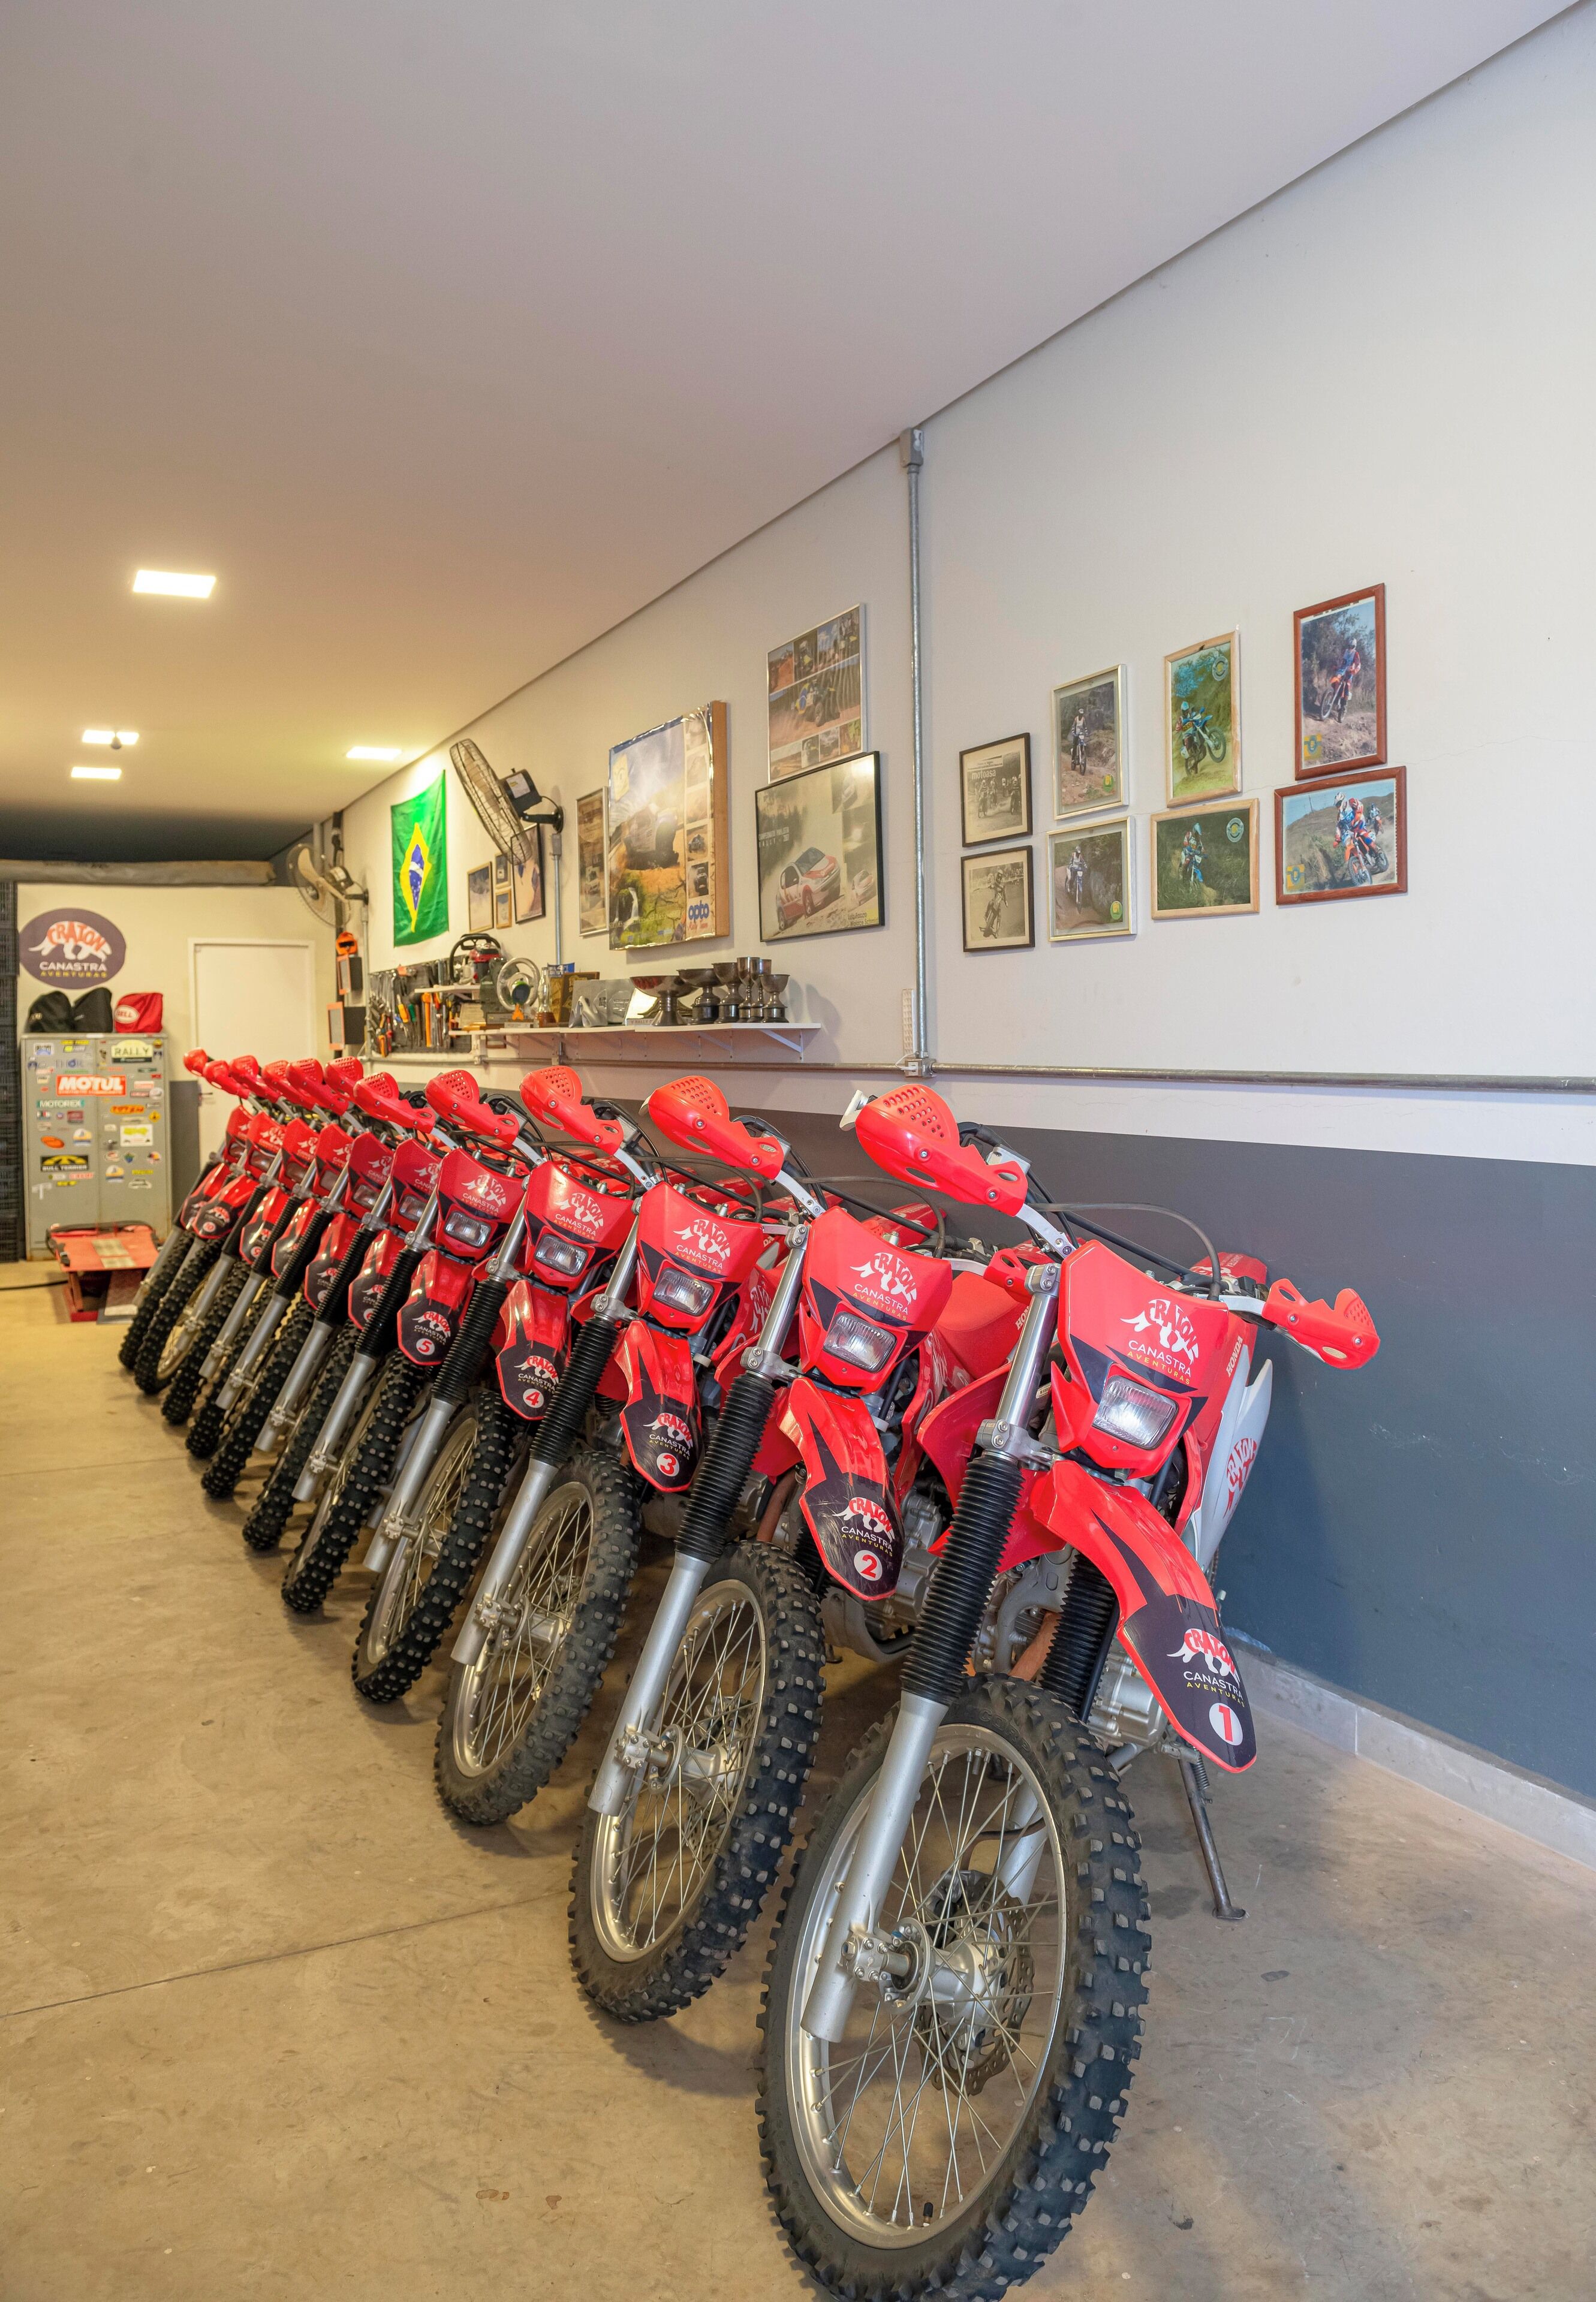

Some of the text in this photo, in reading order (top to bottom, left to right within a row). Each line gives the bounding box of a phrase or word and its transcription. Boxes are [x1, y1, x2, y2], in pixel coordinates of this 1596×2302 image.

[972, 770, 996, 780] motoasa
[688, 900, 709, 924] opto
[47, 921, 106, 951] CRATON
[40, 962, 107, 972] CANASTRA
[114, 1046, 150, 1056] RALLY
[58, 1077, 124, 1090] MOTUL
[39, 1099, 81, 1108] MOTOREX
[463, 1193, 499, 1213] CANASTRA
[553, 1219, 595, 1240] AVENTURAS
[555, 1213, 596, 1236] CANASTRA
[675, 1252, 721, 1274] AVENTURAS
[676, 1245, 722, 1269] CANASTRA
[853, 1292, 907, 1321] AVENTURAS
[854, 1283, 908, 1315] CANASTRA
[423, 1311, 450, 1332] CRATON
[414, 1324, 447, 1343] CANASTRA
[418, 1340, 432, 1353] 5
[1226, 1335, 1243, 1378] HONDA
[526, 1355, 558, 1379] CRATON
[1127, 1351, 1191, 1385] AVENTURAS
[1128, 1340, 1192, 1378] CANASTRA
[517, 1378, 555, 1394] AVENTURAS
[518, 1373, 555, 1391] CANASTRA
[525, 1391, 540, 1406] 4
[657, 1413, 691, 1441] CRATON
[649, 1434, 690, 1457] CANASTRA
[649, 1439, 689, 1460] AVENTURAS
[660, 1454, 676, 1475] 3
[848, 1497, 892, 1532] CRATON
[841, 1526, 893, 1552] CANASTRA
[842, 1533, 893, 1557] AVENTURAS
[860, 1554, 878, 1578] 2
[1184, 1629, 1236, 1674] CRATON
[1183, 1671, 1243, 1701] CANASTRA
[1187, 1682, 1245, 1708] AVENTURAS
[1218, 1704, 1233, 1742] 1
